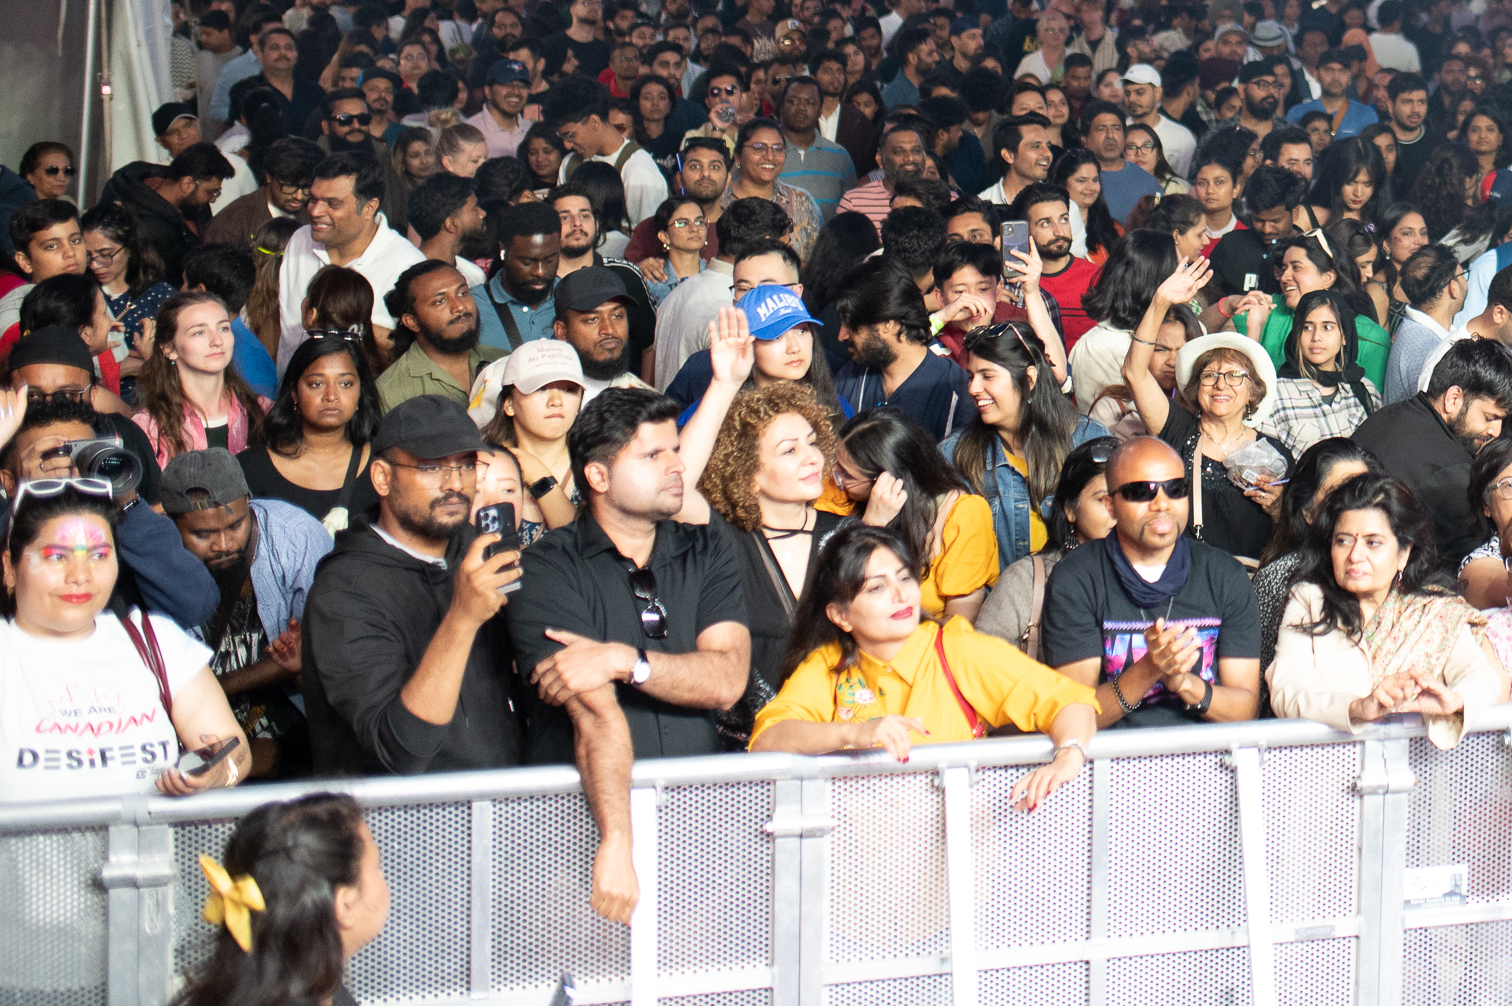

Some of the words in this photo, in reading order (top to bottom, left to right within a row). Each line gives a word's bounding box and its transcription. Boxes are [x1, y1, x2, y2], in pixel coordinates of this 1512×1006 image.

[757, 294, 804, 322] MALIBU
[35, 708, 156, 738] CANADIAN
[59, 708, 83, 717] WE
[87, 706, 118, 715] ARE
